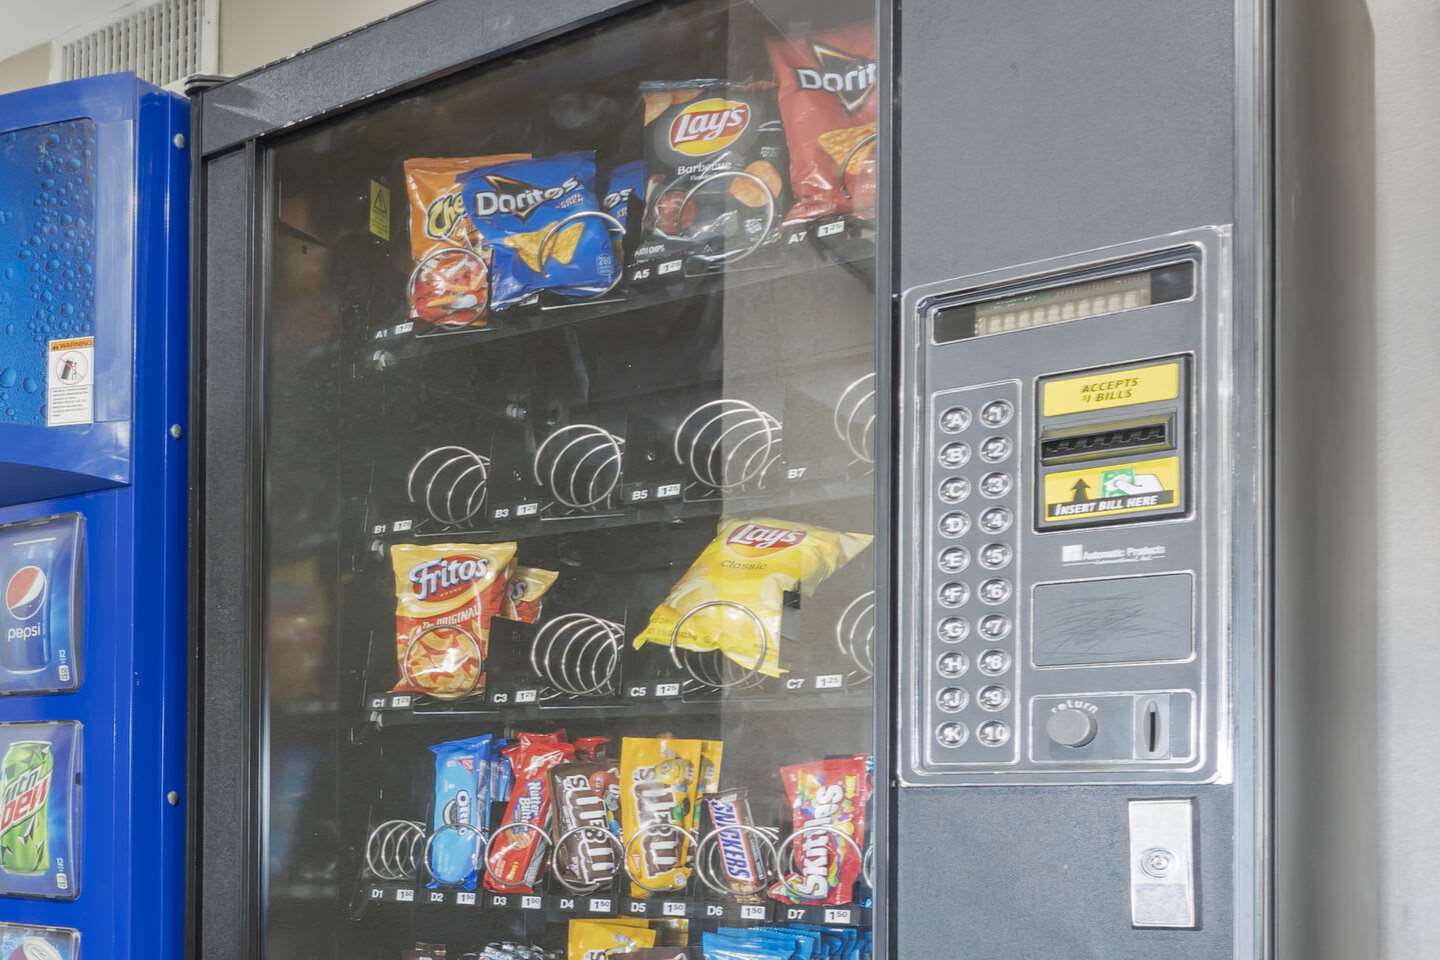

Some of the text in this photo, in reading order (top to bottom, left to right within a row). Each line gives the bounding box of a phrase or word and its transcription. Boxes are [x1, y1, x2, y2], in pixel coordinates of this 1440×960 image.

[673, 102, 747, 144] Lay's
[475, 176, 582, 217] Doritos
[788, 231, 807, 244] A7
[633, 268, 650, 281] A5
[1081, 377, 1140, 393] ACCEPTS
[1096, 389, 1132, 401] BILLS
[786, 467, 807, 480] B7
[632, 489, 648, 501] B5
[1055, 495, 1159, 516] INSERT BILL HERE
[495, 508, 510, 518] B3
[374, 524, 387, 534] B1
[721, 559, 768, 570] Classic
[409, 558, 489, 601] Fritos
[7, 621, 41, 642] pepsi
[786, 679, 805, 689] C7
[631, 686, 647, 697] C5
[372, 698, 385, 708] C1
[494, 693, 508, 703] C3
[1050, 699, 1099, 715] return
[456, 790, 470, 836] OREO
[710, 799, 752, 880] SNICKERS
[371, 889, 384, 899] D1
[430, 892, 444, 902] D2
[493, 895, 507, 906] D3
[560, 899, 575, 909] D4
[631, 903, 647, 913] D5
[707, 904, 724, 916] D6
[788, 909, 805, 920] D7
